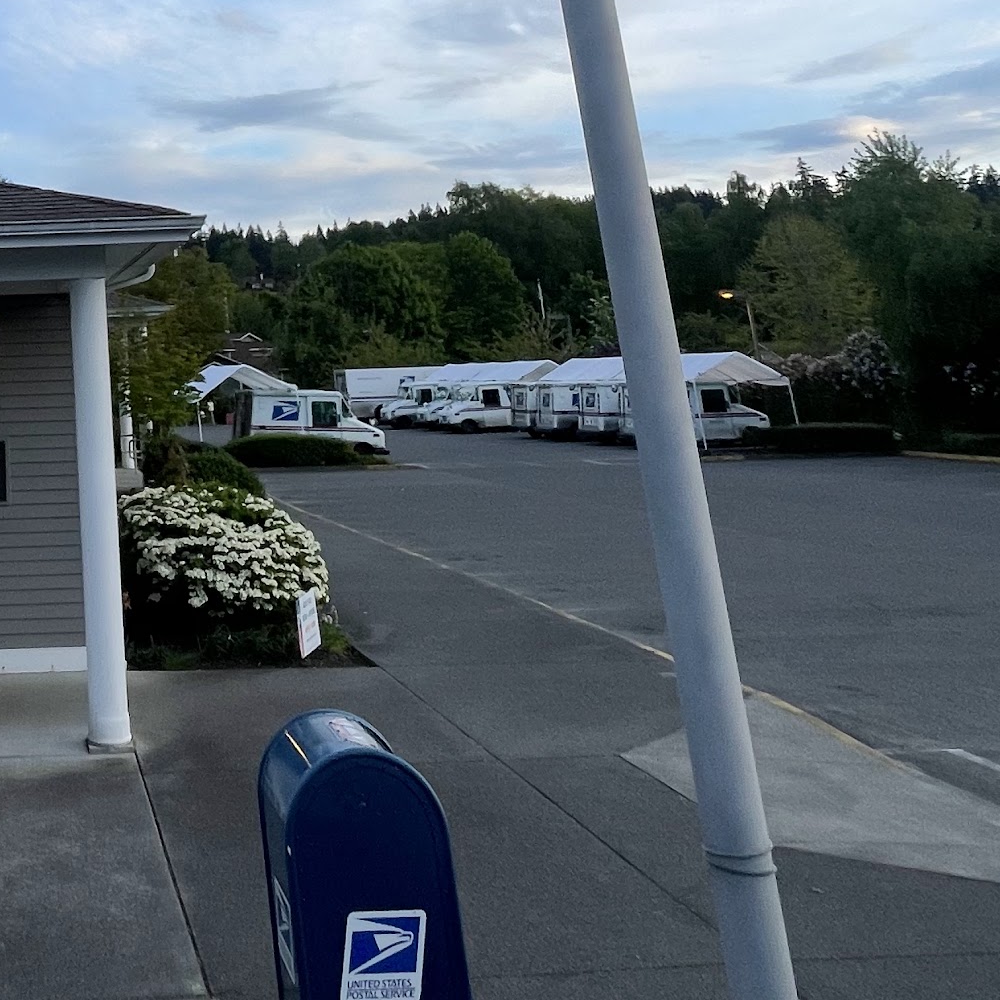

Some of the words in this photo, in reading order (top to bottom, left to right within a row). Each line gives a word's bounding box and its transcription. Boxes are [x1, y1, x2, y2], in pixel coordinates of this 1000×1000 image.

[347, 979, 380, 989] UNITED
[382, 978, 413, 988] STATES
[346, 988, 379, 1000] POSTAL
[380, 987, 416, 999] SERVICE
